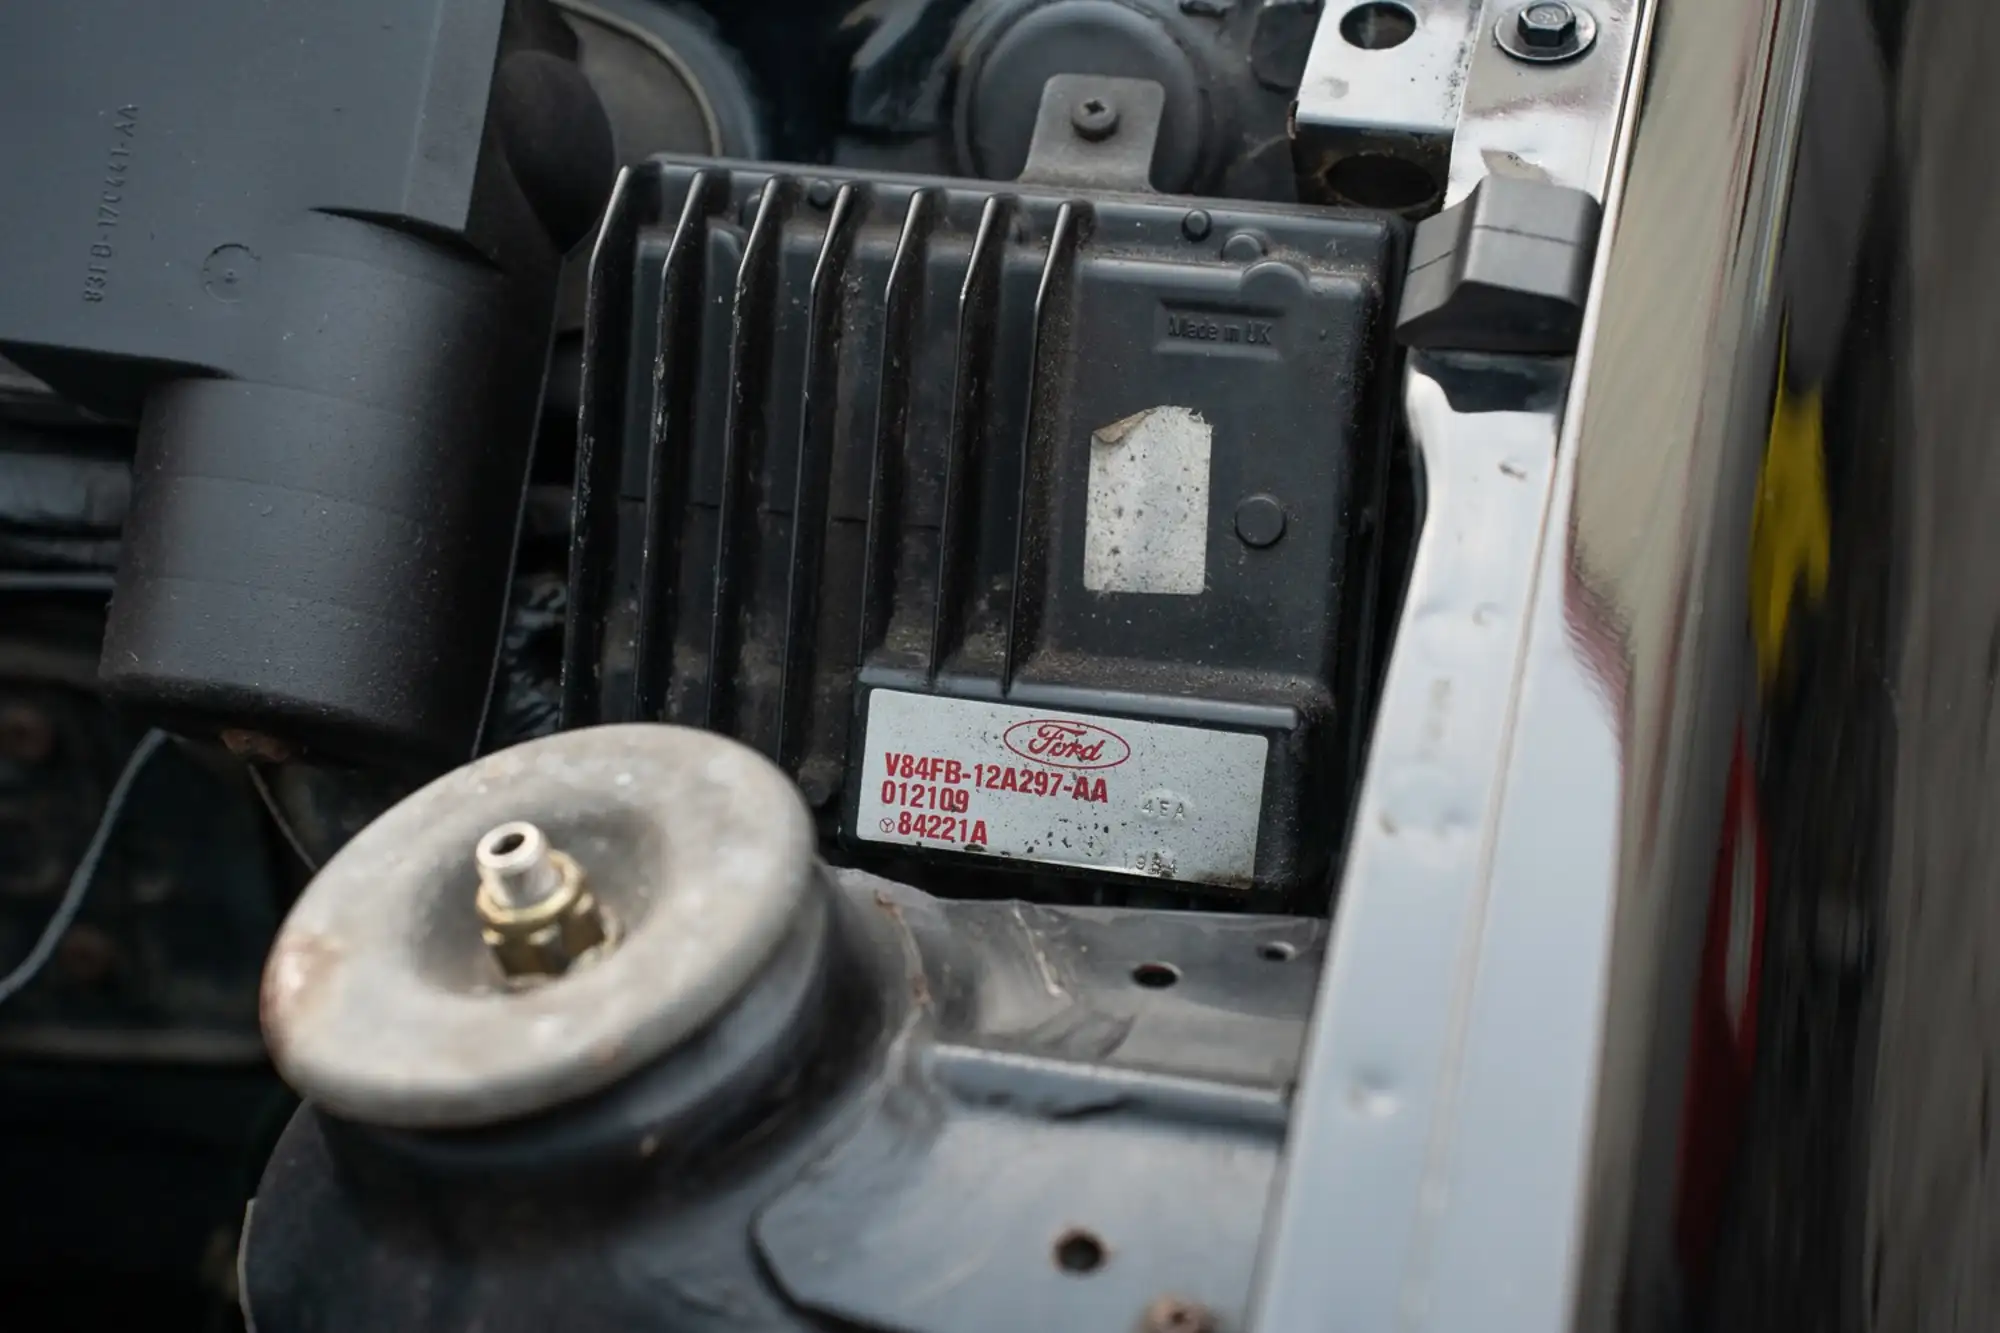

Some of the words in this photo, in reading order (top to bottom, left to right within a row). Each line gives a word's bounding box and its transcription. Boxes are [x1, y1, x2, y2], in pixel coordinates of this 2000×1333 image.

[1168, 314, 1219, 342] Made
[1223, 323, 1241, 343] in
[1246, 320, 1273, 346] UK
[1025, 722, 1107, 763] Ford
[885, 752, 1108, 804] V84FB-12A297-AA
[881, 780, 970, 814] 012109
[897, 811, 988, 845] 84221A
